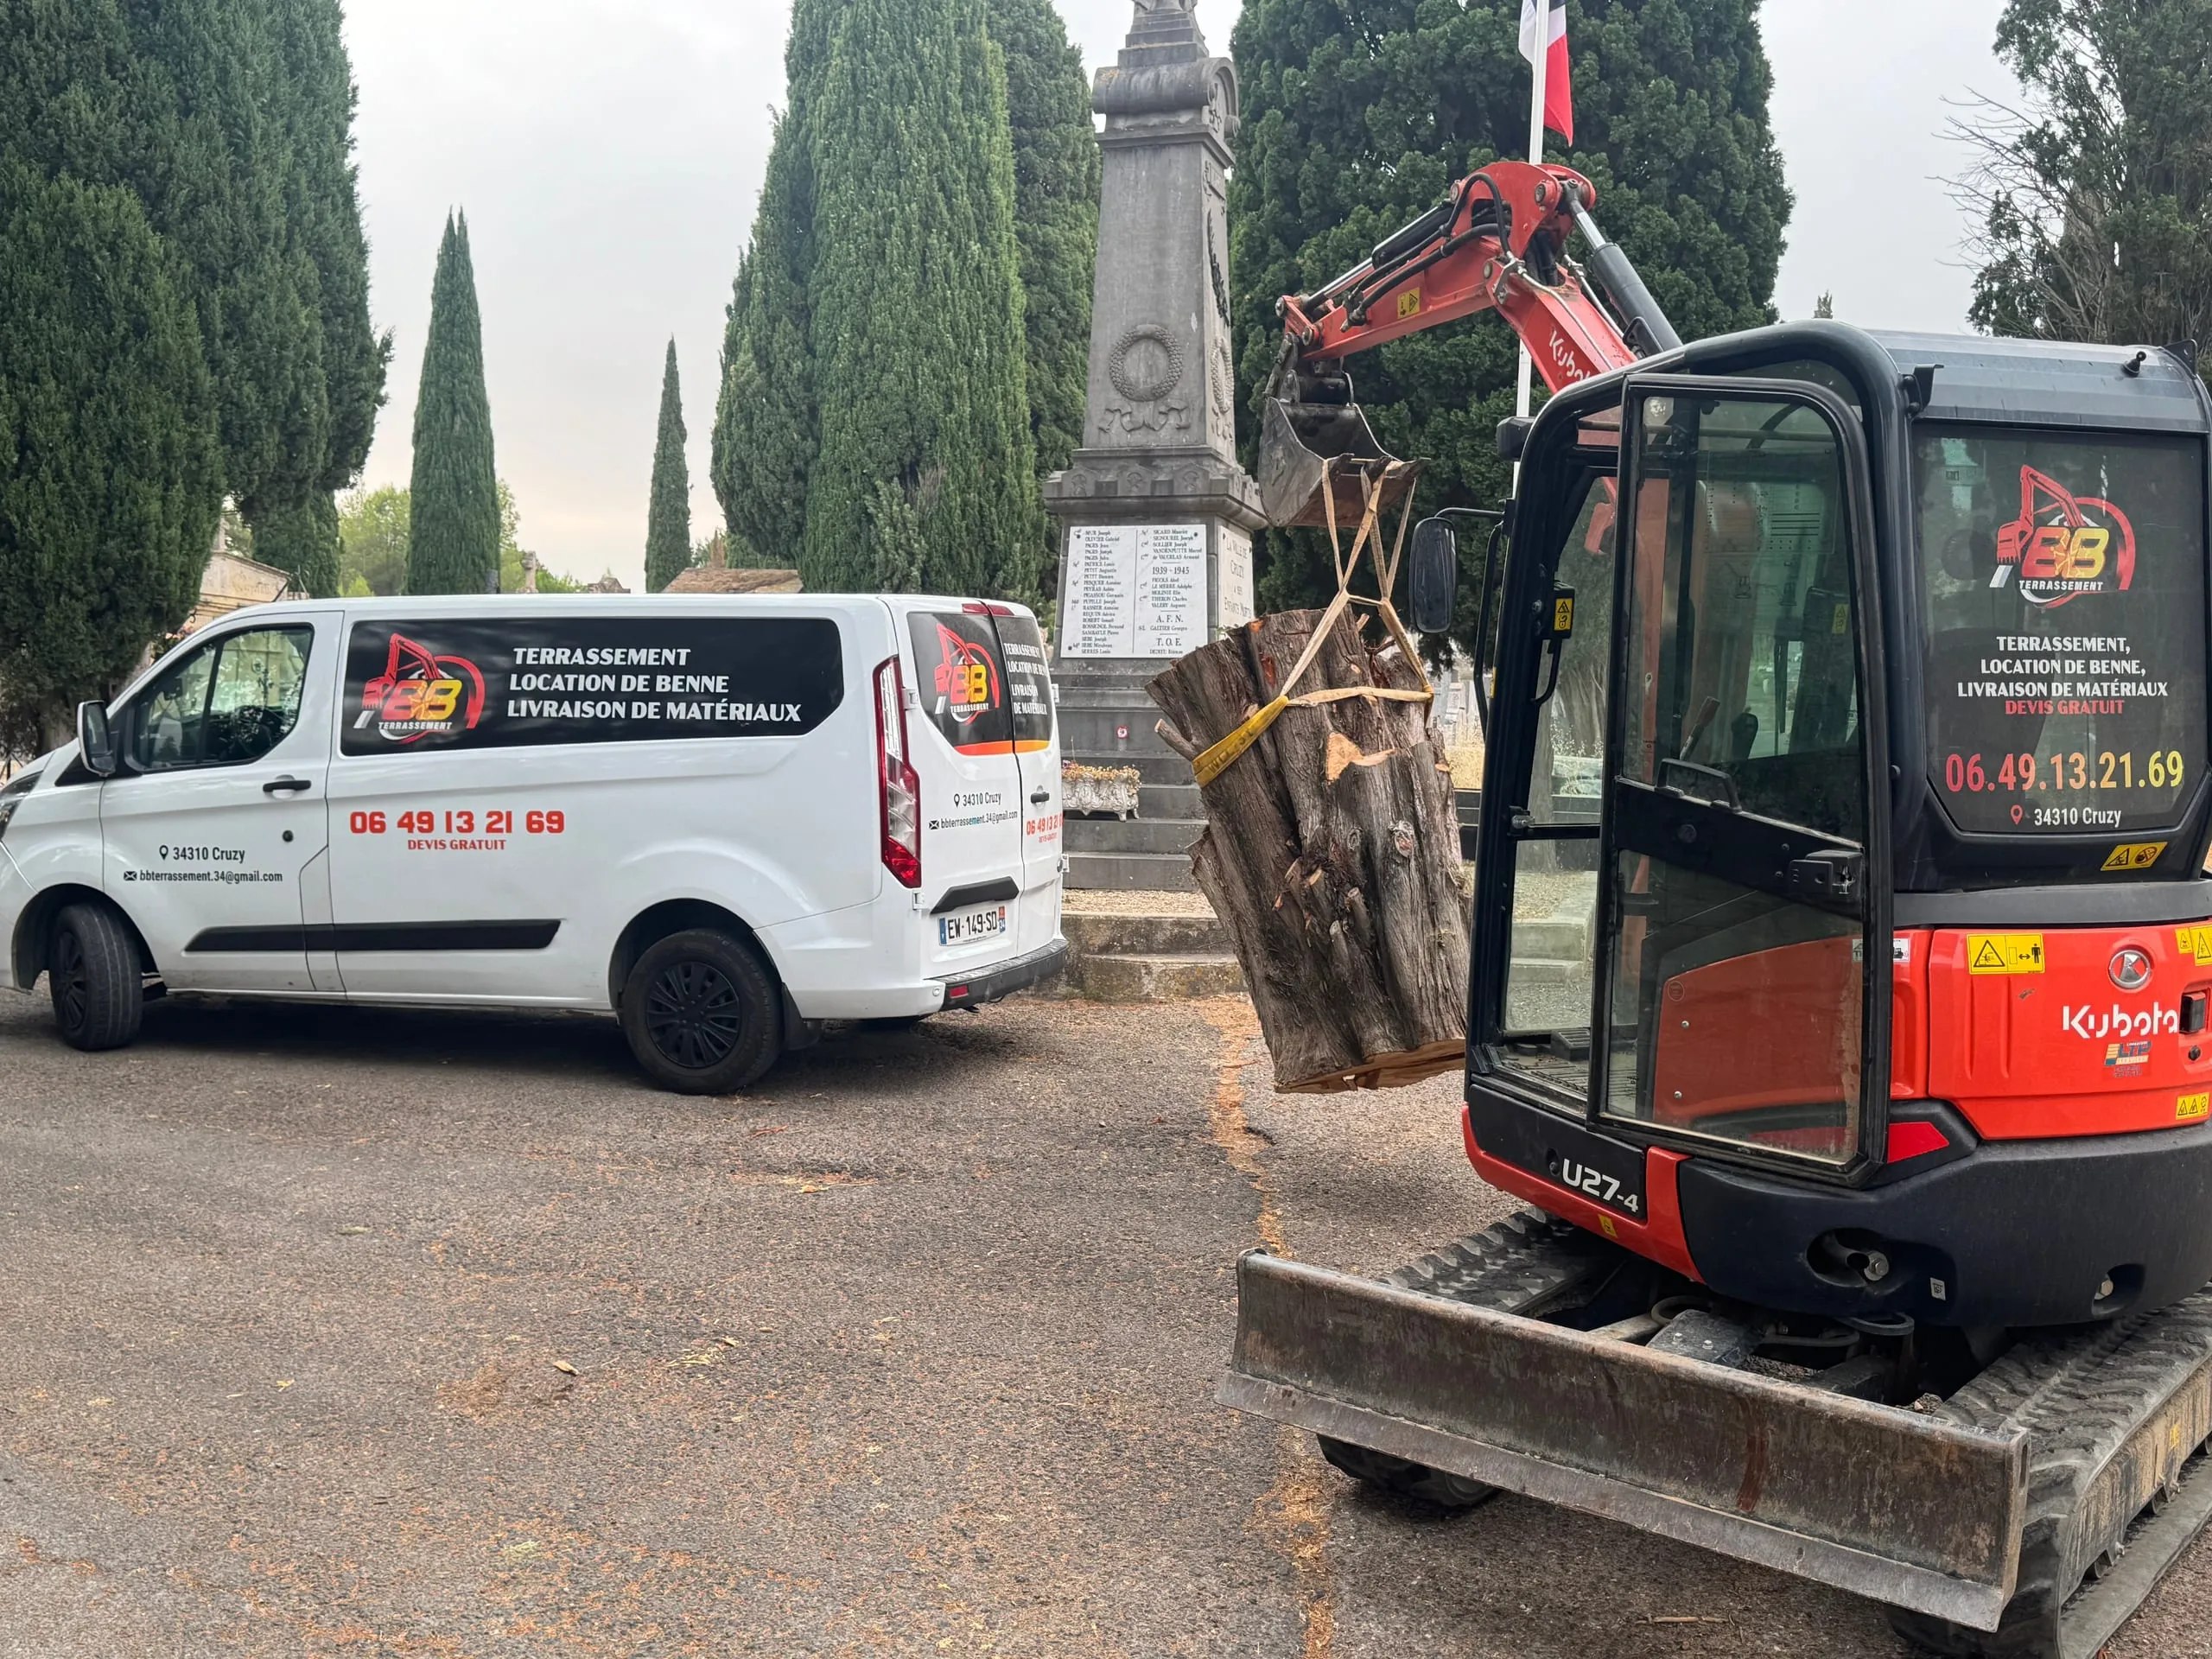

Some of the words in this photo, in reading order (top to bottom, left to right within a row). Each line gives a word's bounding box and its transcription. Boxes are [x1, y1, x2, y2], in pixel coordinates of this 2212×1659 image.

[1549, 330, 1591, 380] Kubo
[1152, 566, 1168, 575] 1939
[1173, 566, 1190, 575] 1945
[2018, 580, 2103, 591] TERRASSEMENT
[1996, 636, 2131, 654] TERRASSEMENT,
[513, 647, 691, 667] TERRASSEMENT
[1980, 658, 2061, 674] LOCATION
[2064, 659, 2086, 674] DE
[2089, 659, 2146, 677] BENNE,
[509, 673, 616, 692] LOCATION
[620, 674, 651, 692] DE
[655, 675, 729, 693] BENNE
[1957, 682, 2048, 697] LIVRAISON
[2051, 682, 2073, 697] DE
[2076, 678, 2169, 697] MATÉRIAUX
[507, 699, 626, 719] LIVRAISON
[631, 702, 660, 720] DE
[665, 697, 801, 722] MATÉRIAUX
[2005, 700, 2055, 715] DEVIS
[2057, 699, 2126, 715] GRATUIT
[378, 721, 453, 730] TERRASSEMENT
[1945, 750, 2183, 792] 06.49.13.21.69
[962, 792, 983, 807] 34310
[984, 791, 1001, 805] Cruzy
[350, 810, 386, 834] 06
[397, 810, 434, 834] 49
[445, 810, 474, 834] 13
[486, 810, 512, 834] 21
[525, 810, 565, 834] 69
[1027, 820, 1036, 836] 06
[1037, 817, 1046, 832] 49
[2034, 807, 2078, 826] 34310
[2082, 807, 2122, 828] Cruzy
[408, 839, 448, 851] DEVIS
[449, 839, 506, 851] GRATUIT
[173, 847, 208, 861] 34310
[213, 847, 245, 864] Cruzy
[139, 869, 283, 884] bbterrassement.34@gmail.com
[2063, 1001, 2178, 1039] Kubota
[1562, 1158, 1639, 1213] U27-4
